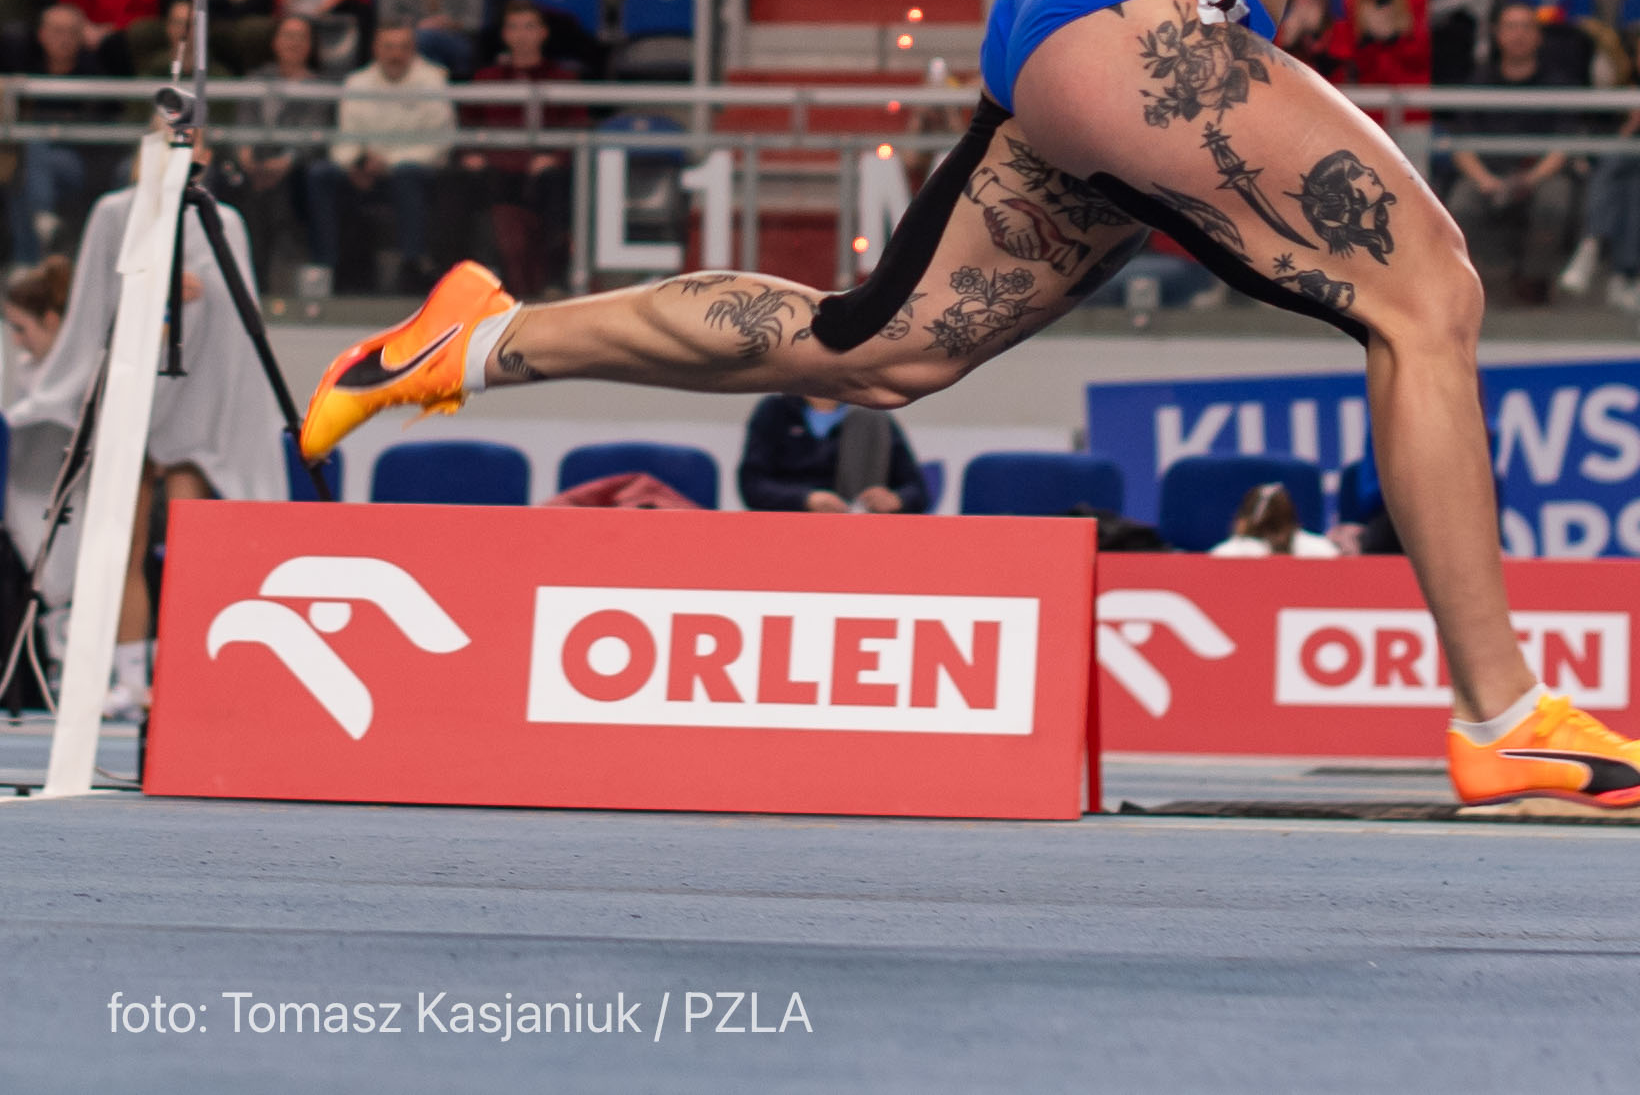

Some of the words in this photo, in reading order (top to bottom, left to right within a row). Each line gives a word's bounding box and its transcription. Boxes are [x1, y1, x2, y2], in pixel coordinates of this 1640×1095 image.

[594, 148, 734, 272] L1
[560, 608, 1001, 711] ORLEN
[1299, 625, 1604, 691] ORN
